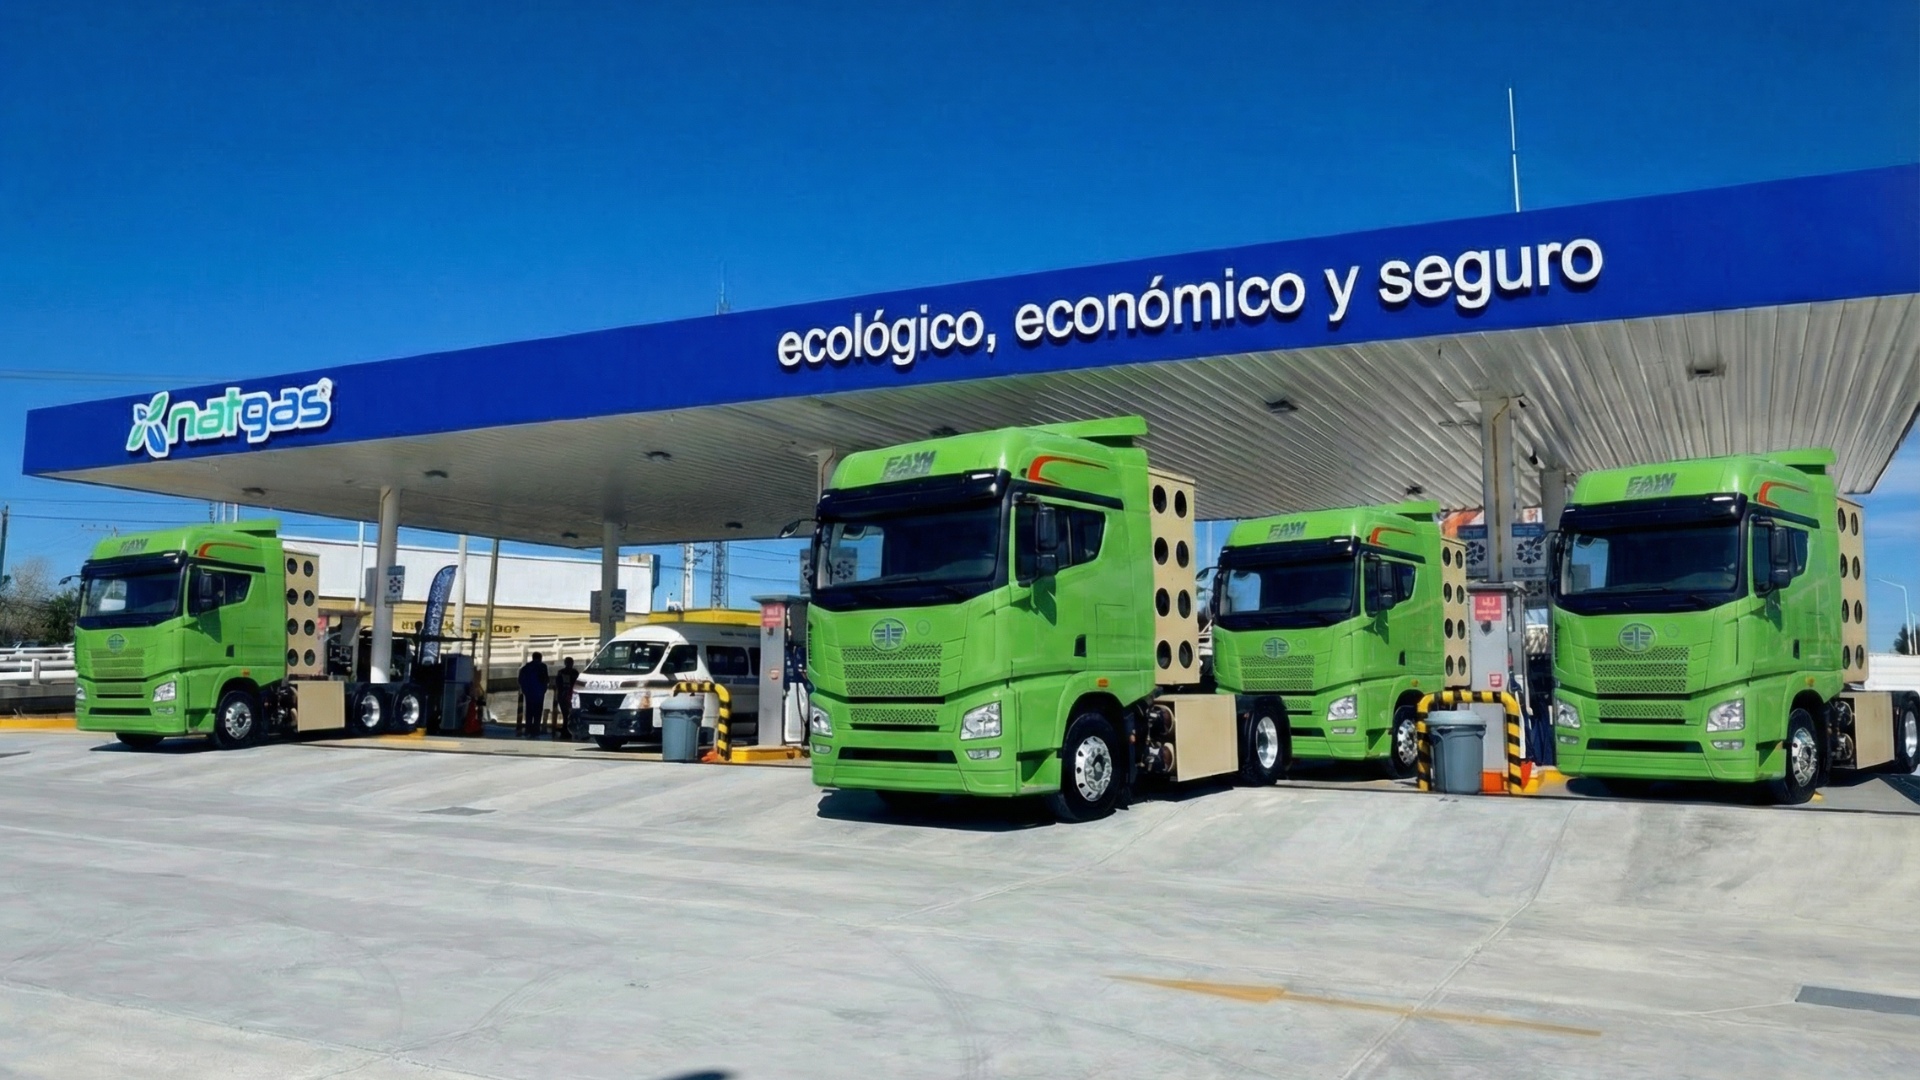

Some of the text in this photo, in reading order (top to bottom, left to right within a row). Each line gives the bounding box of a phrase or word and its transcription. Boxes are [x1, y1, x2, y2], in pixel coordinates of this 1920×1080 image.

[777, 237, 1604, 366] ecológico, económico y seguro
[167, 384, 331, 441] natgas
